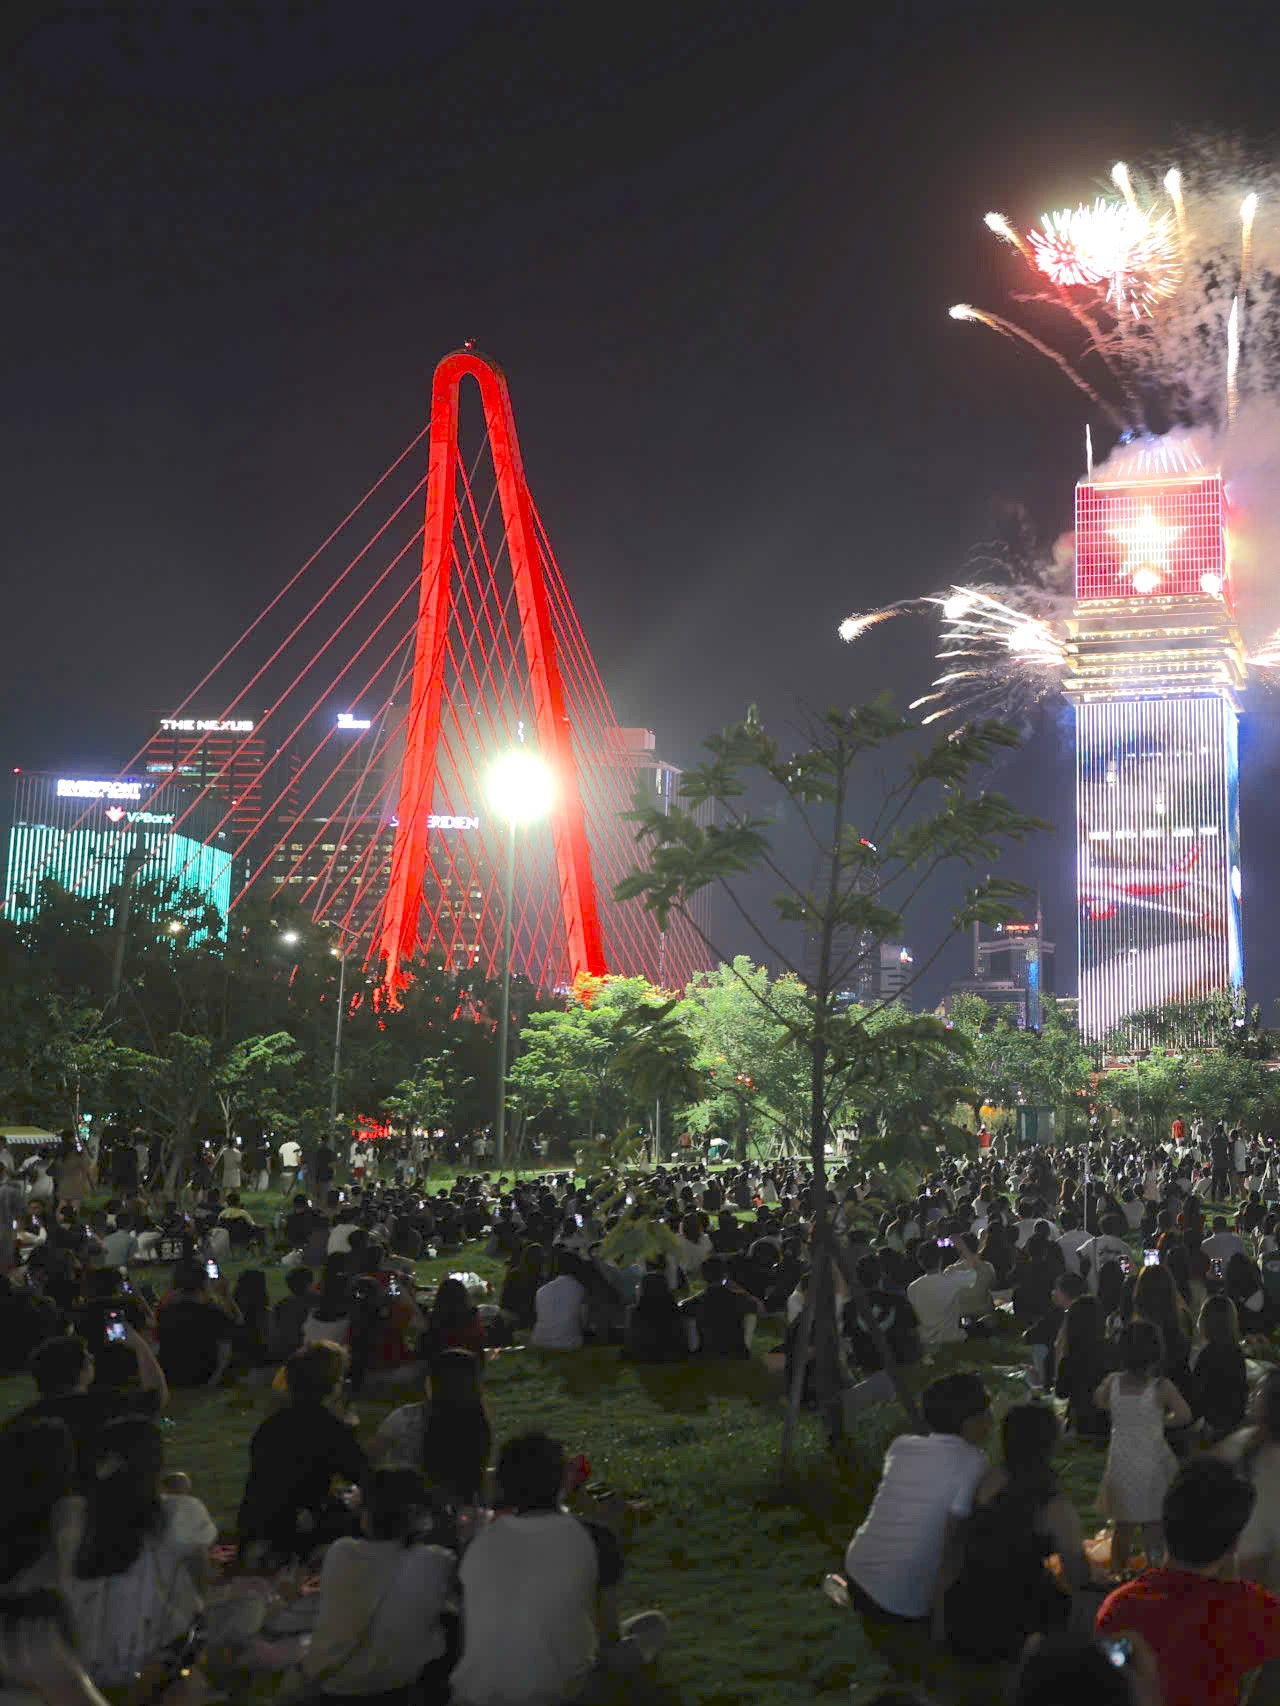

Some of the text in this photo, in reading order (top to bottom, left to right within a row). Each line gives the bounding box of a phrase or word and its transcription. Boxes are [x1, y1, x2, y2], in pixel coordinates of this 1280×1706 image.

[160, 719, 254, 731] THE NEXUS
[127, 812, 175, 824] VPBank
